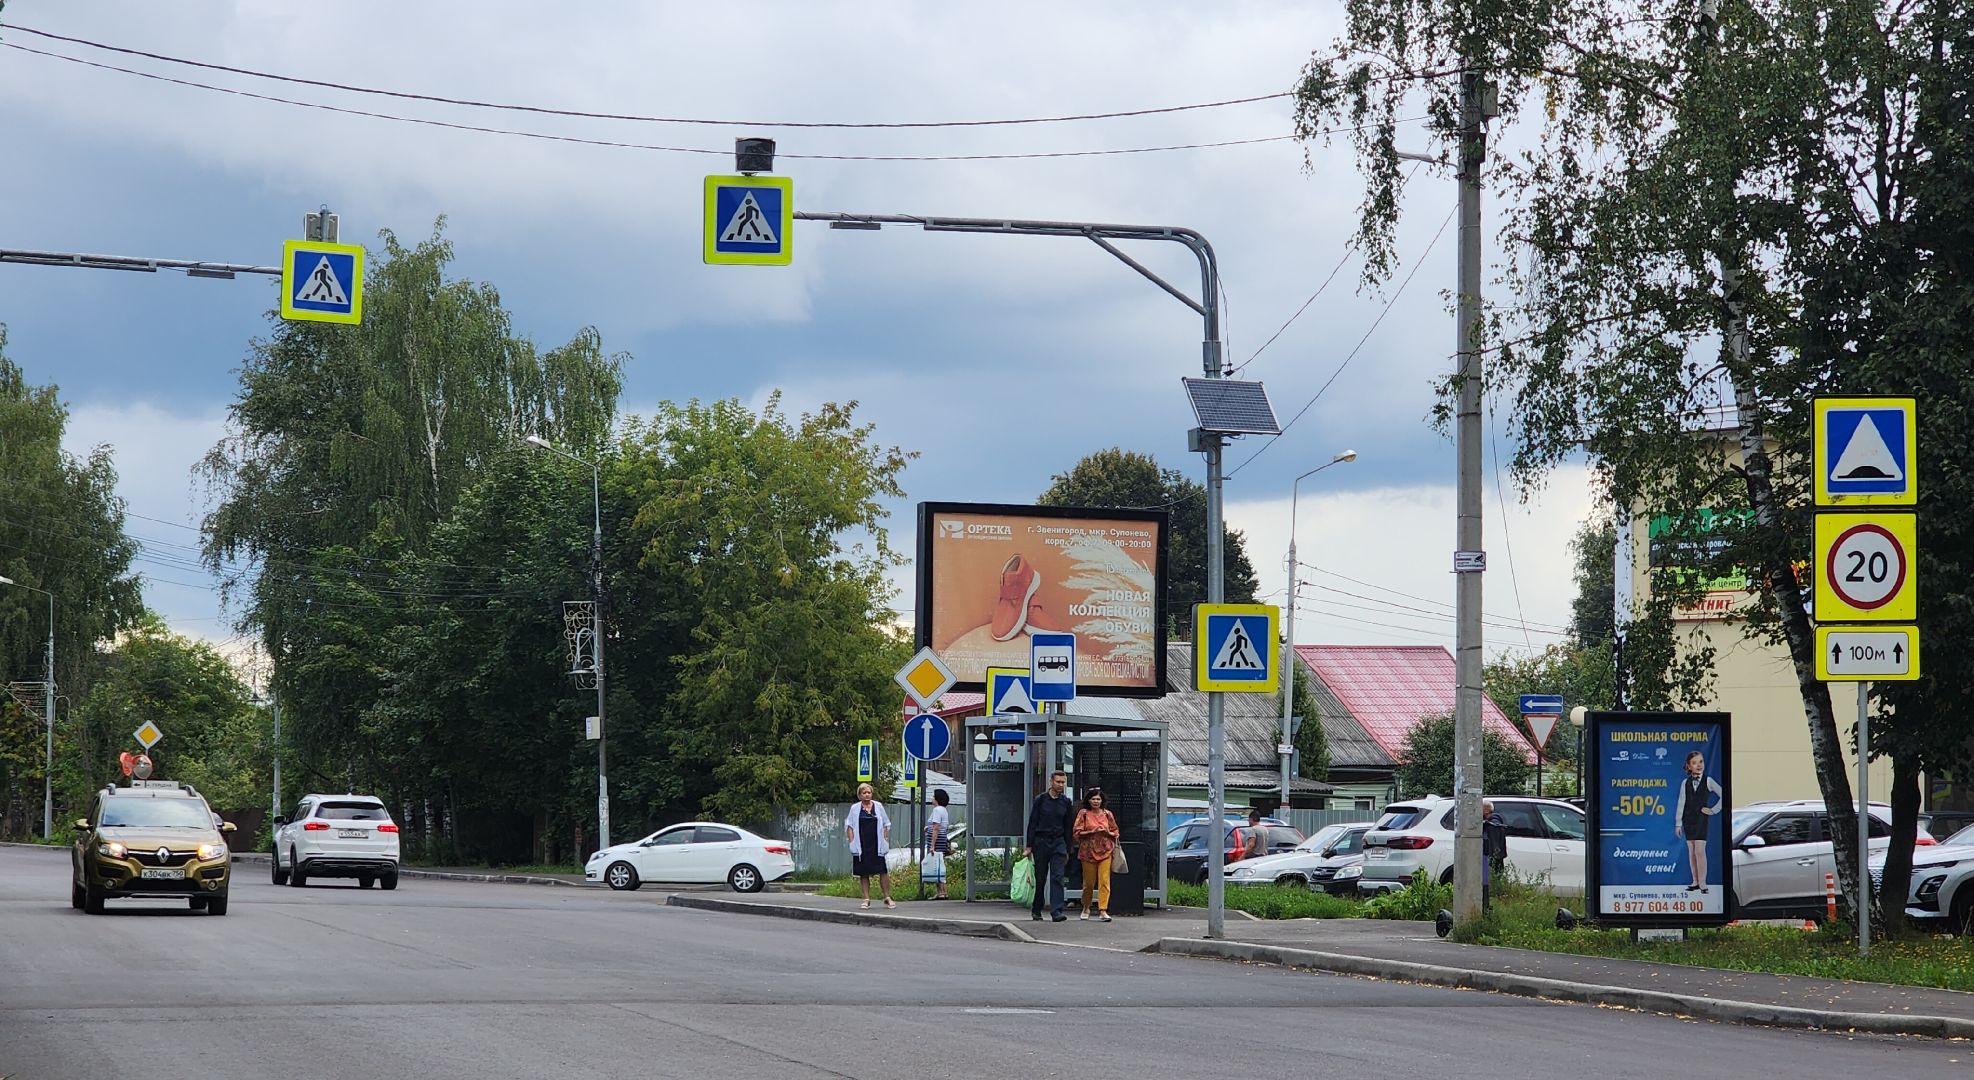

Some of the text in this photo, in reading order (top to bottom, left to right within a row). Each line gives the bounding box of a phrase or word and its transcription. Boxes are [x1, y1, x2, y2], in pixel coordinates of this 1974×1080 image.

[967, 524, 1012, 535] ОРТЕКА
[1036, 525, 1087, 536] Звенигород,
[1088, 528, 1108, 537] мкр.
[1110, 528, 1152, 539] Супонево,
[1845, 551, 1888, 583] 20
[1106, 589, 1151, 602] НОВАЯ
[1069, 604, 1150, 619] КОЛЛЕКЦИЯ
[1105, 621, 1150, 634] ОБУВИ
[1849, 645, 1886, 661] 100м
[1611, 731, 1709, 742] ШКОЛЬНАЯ ФОРМА
[1611, 779, 1668, 788] РАСПРОДАЖА
[1612, 795, 1666, 816] -50%
[1613, 846, 1669, 860] доступные
[1645, 862, 1677, 874] цены!
[1629, 892, 1660, 900] Супонево,
[1614, 901, 1703, 912] 8 977 604 48 00
